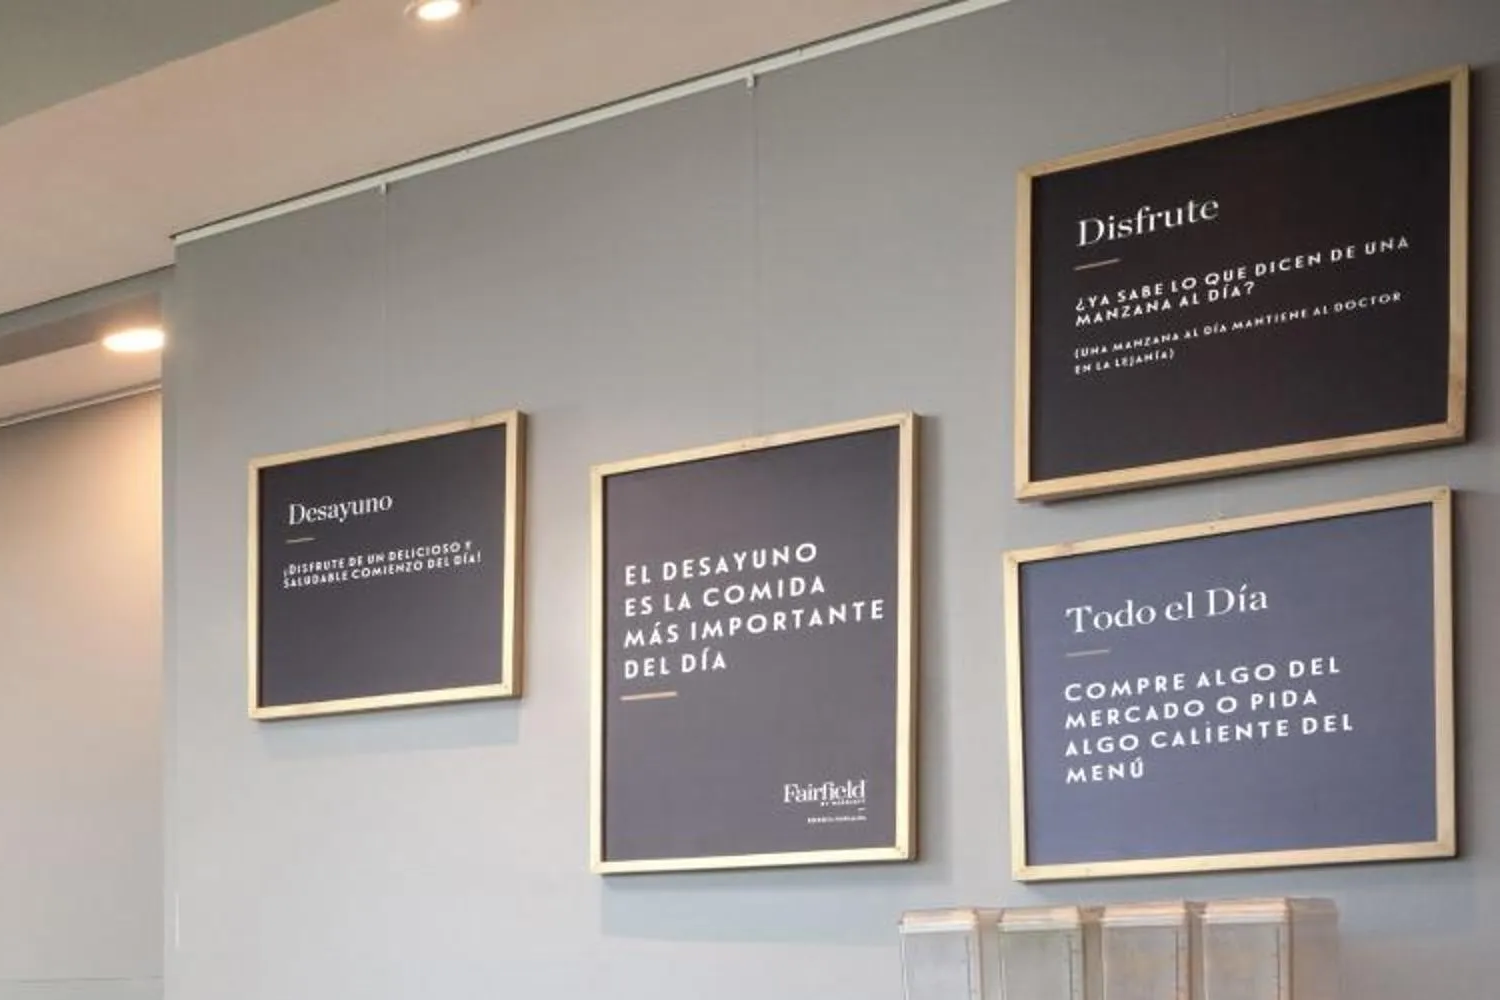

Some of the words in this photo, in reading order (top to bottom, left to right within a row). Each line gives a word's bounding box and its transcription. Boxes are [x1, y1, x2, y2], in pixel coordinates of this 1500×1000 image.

[1076, 198, 1219, 247] Disfrute
[1075, 295, 1110, 312] ¿YA
[1117, 283, 1164, 303] SABE
[1171, 277, 1197, 293] LO
[1205, 266, 1247, 286] QUE
[1255, 251, 1322, 277] DICEN
[1330, 245, 1356, 262] DE
[1365, 236, 1409, 255] UNA
[1075, 300, 1171, 327] MANZANA
[1179, 293, 1200, 308] AL
[1208, 281, 1255, 303] DÍA?
[1112, 333, 1179, 352] MANZANA
[1184, 328, 1198, 340] AL
[1203, 322, 1227, 336] DÍA
[1231, 308, 1308, 331] MANTIENE
[1312, 305, 1329, 317] AL
[1333, 291, 1402, 313] DOCTOR
[1075, 364, 1092, 375] EN
[1096, 360, 1111, 372] LA
[288, 494, 393, 525] Desayuno
[283, 570, 349, 590] SALUDABLE
[351, 560, 423, 579] COMIENZO
[427, 556, 450, 569] DEL
[348, 555, 363, 567] DE
[367, 552, 385, 565] UN
[388, 541, 461, 562] DELICIOSO
[464, 540, 473, 551] Y
[625, 565, 652, 587] EL
[662, 542, 817, 581] DESAYUNO
[625, 596, 653, 617] ES
[664, 592, 692, 613] LA
[702, 575, 825, 608] COMIDA
[1065, 600, 1156, 634] Todo
[1165, 591, 1195, 621] el
[1205, 583, 1268, 618] Día
[623, 621, 679, 649] MÁS
[691, 599, 884, 641] IMPORTANTE
[624, 657, 671, 680] DEL
[681, 648, 727, 674] DÍA
[1065, 672, 1186, 703] COMPRE
[1196, 663, 1276, 688] ALGO
[1289, 656, 1341, 677] DEL
[1065, 699, 1205, 730] MERCADO
[1216, 697, 1238, 714] O
[1251, 688, 1318, 710] PIDA
[1065, 734, 1139, 757] ALGO
[1302, 713, 1354, 736] DEL
[783, 779, 866, 803] Fairfield
[1065, 757, 1145, 785] MENÚ
